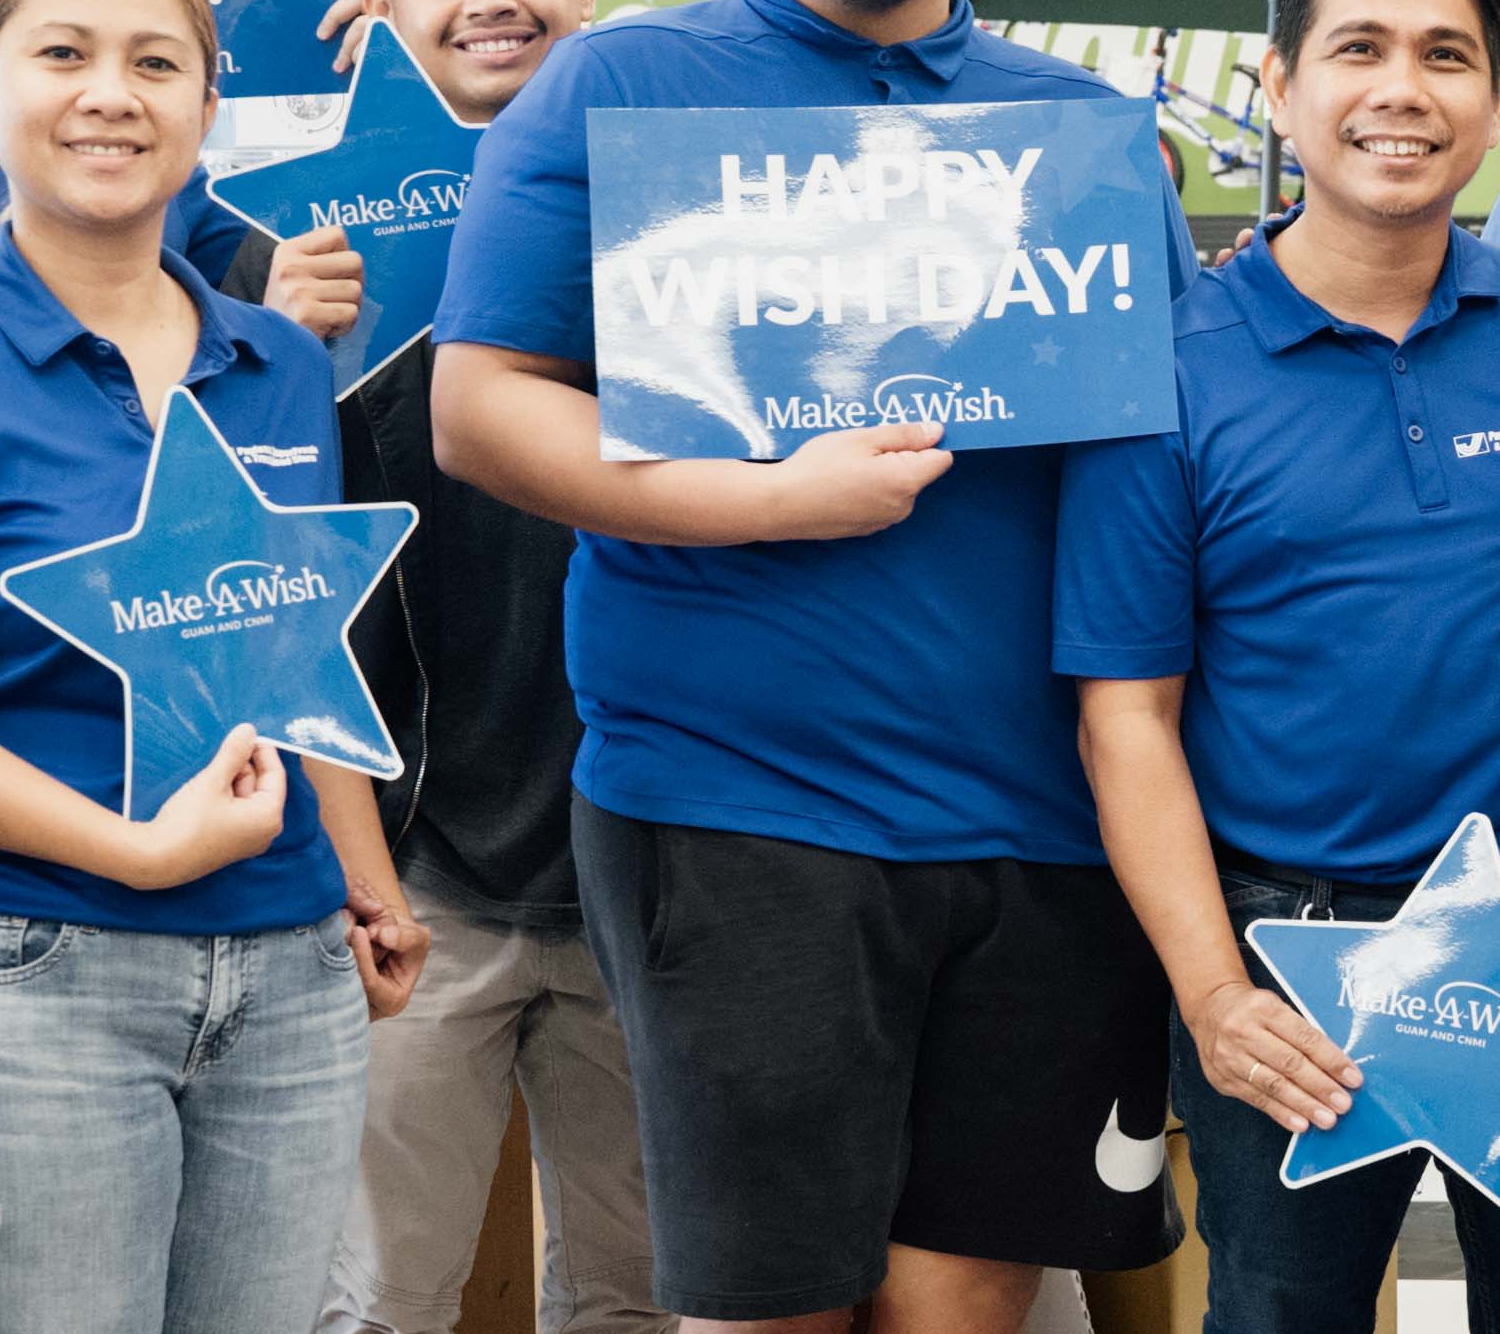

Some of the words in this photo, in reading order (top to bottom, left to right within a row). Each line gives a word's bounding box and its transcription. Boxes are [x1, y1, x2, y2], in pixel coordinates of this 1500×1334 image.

[308, 177, 468, 229] Make-A-W
[719, 147, 1044, 222] HAPPY
[373, 226, 405, 237] GUAM
[407, 221, 430, 232] AND
[431, 217, 458, 228] CNM
[626, 253, 888, 327] WISH
[918, 243, 1132, 324] DAY!
[765, 374, 1016, 430] Make-A-Wish
[111, 561, 336, 635] Make-A-Wish
[180, 624, 216, 640] GUAM
[219, 619, 242, 636] AND
[244, 614, 274, 631] CNMI
[1395, 1023, 1429, 1038] GUAM
[1430, 1028, 1456, 1044] AND
[1457, 1033, 1487, 1049] CNMI
